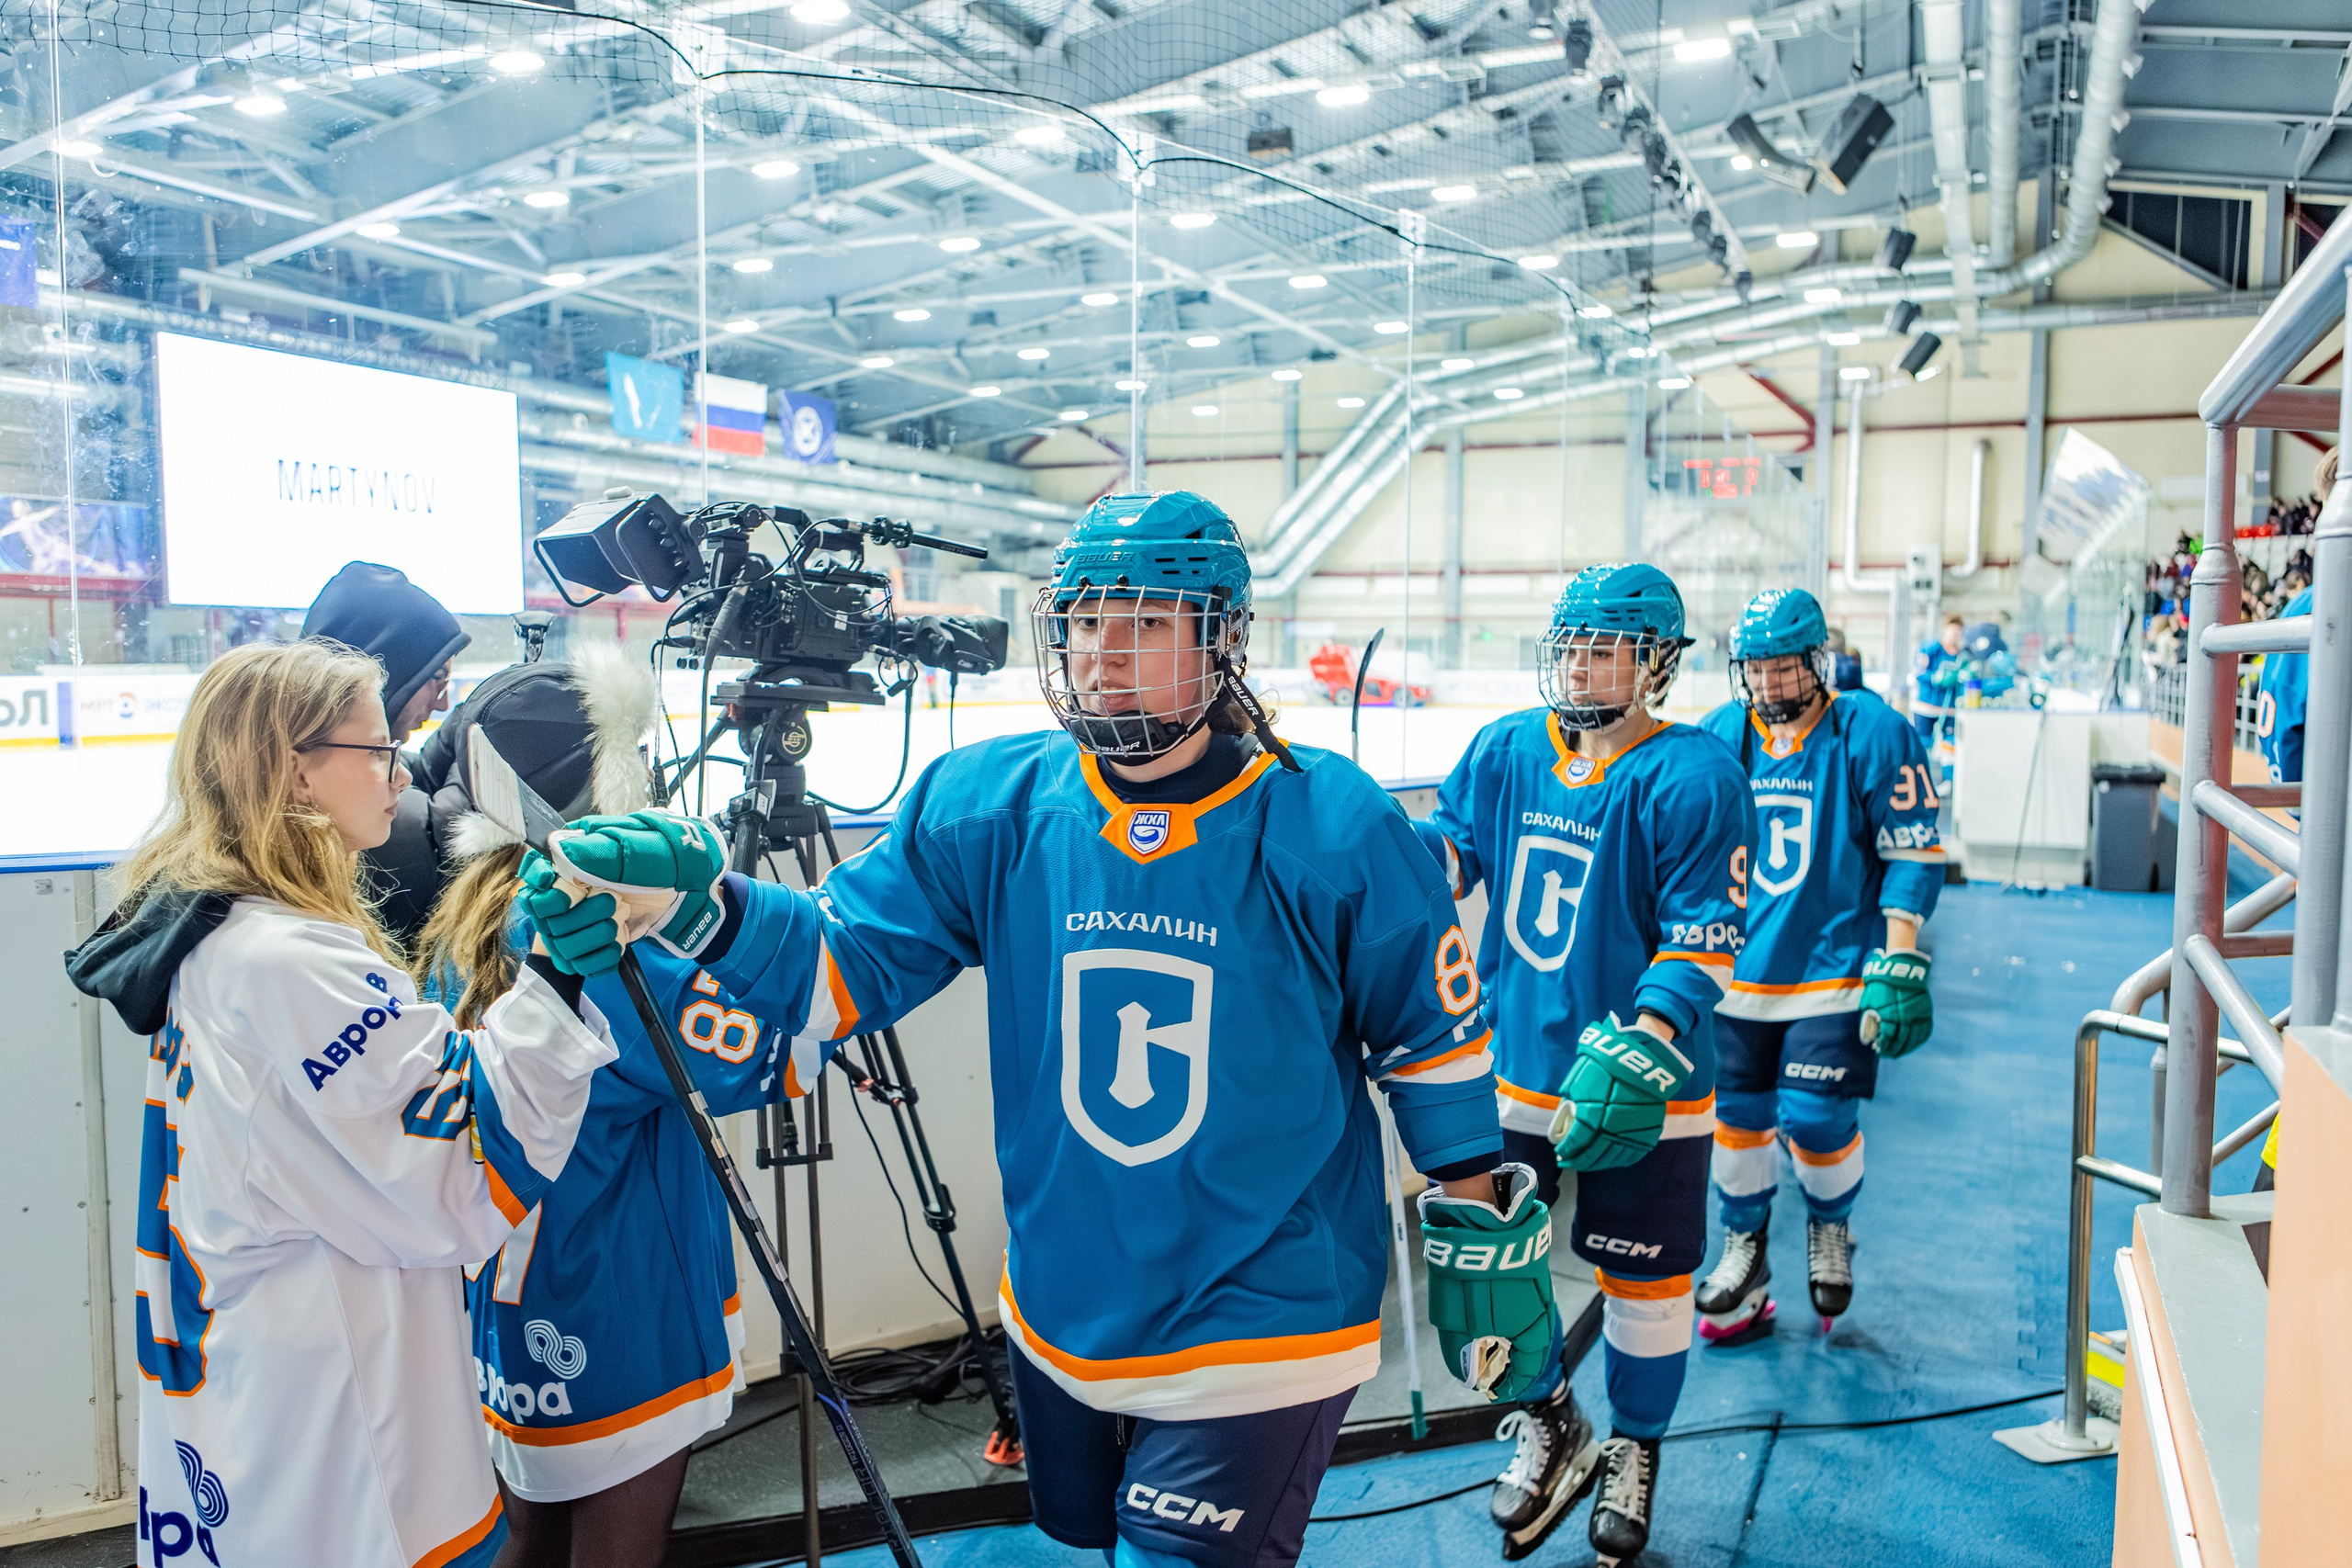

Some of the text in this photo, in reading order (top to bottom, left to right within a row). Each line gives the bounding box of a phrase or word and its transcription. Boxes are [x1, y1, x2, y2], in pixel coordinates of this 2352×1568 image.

[278, 459, 435, 513] MARTYNOV
[1228, 675, 1259, 716] BAUER
[1135, 814, 1165, 826] ЖХЛ
[682, 910, 712, 952] BAUER
[1066, 911, 1217, 947] САХАЛИН
[1578, 1026, 1677, 1093] AUER
[1784, 1062, 1848, 1082] CCM
[1423, 1214, 1552, 1271] BAUE
[1585, 1233, 1663, 1259] CCM
[1126, 1482, 1246, 1533] CCM
